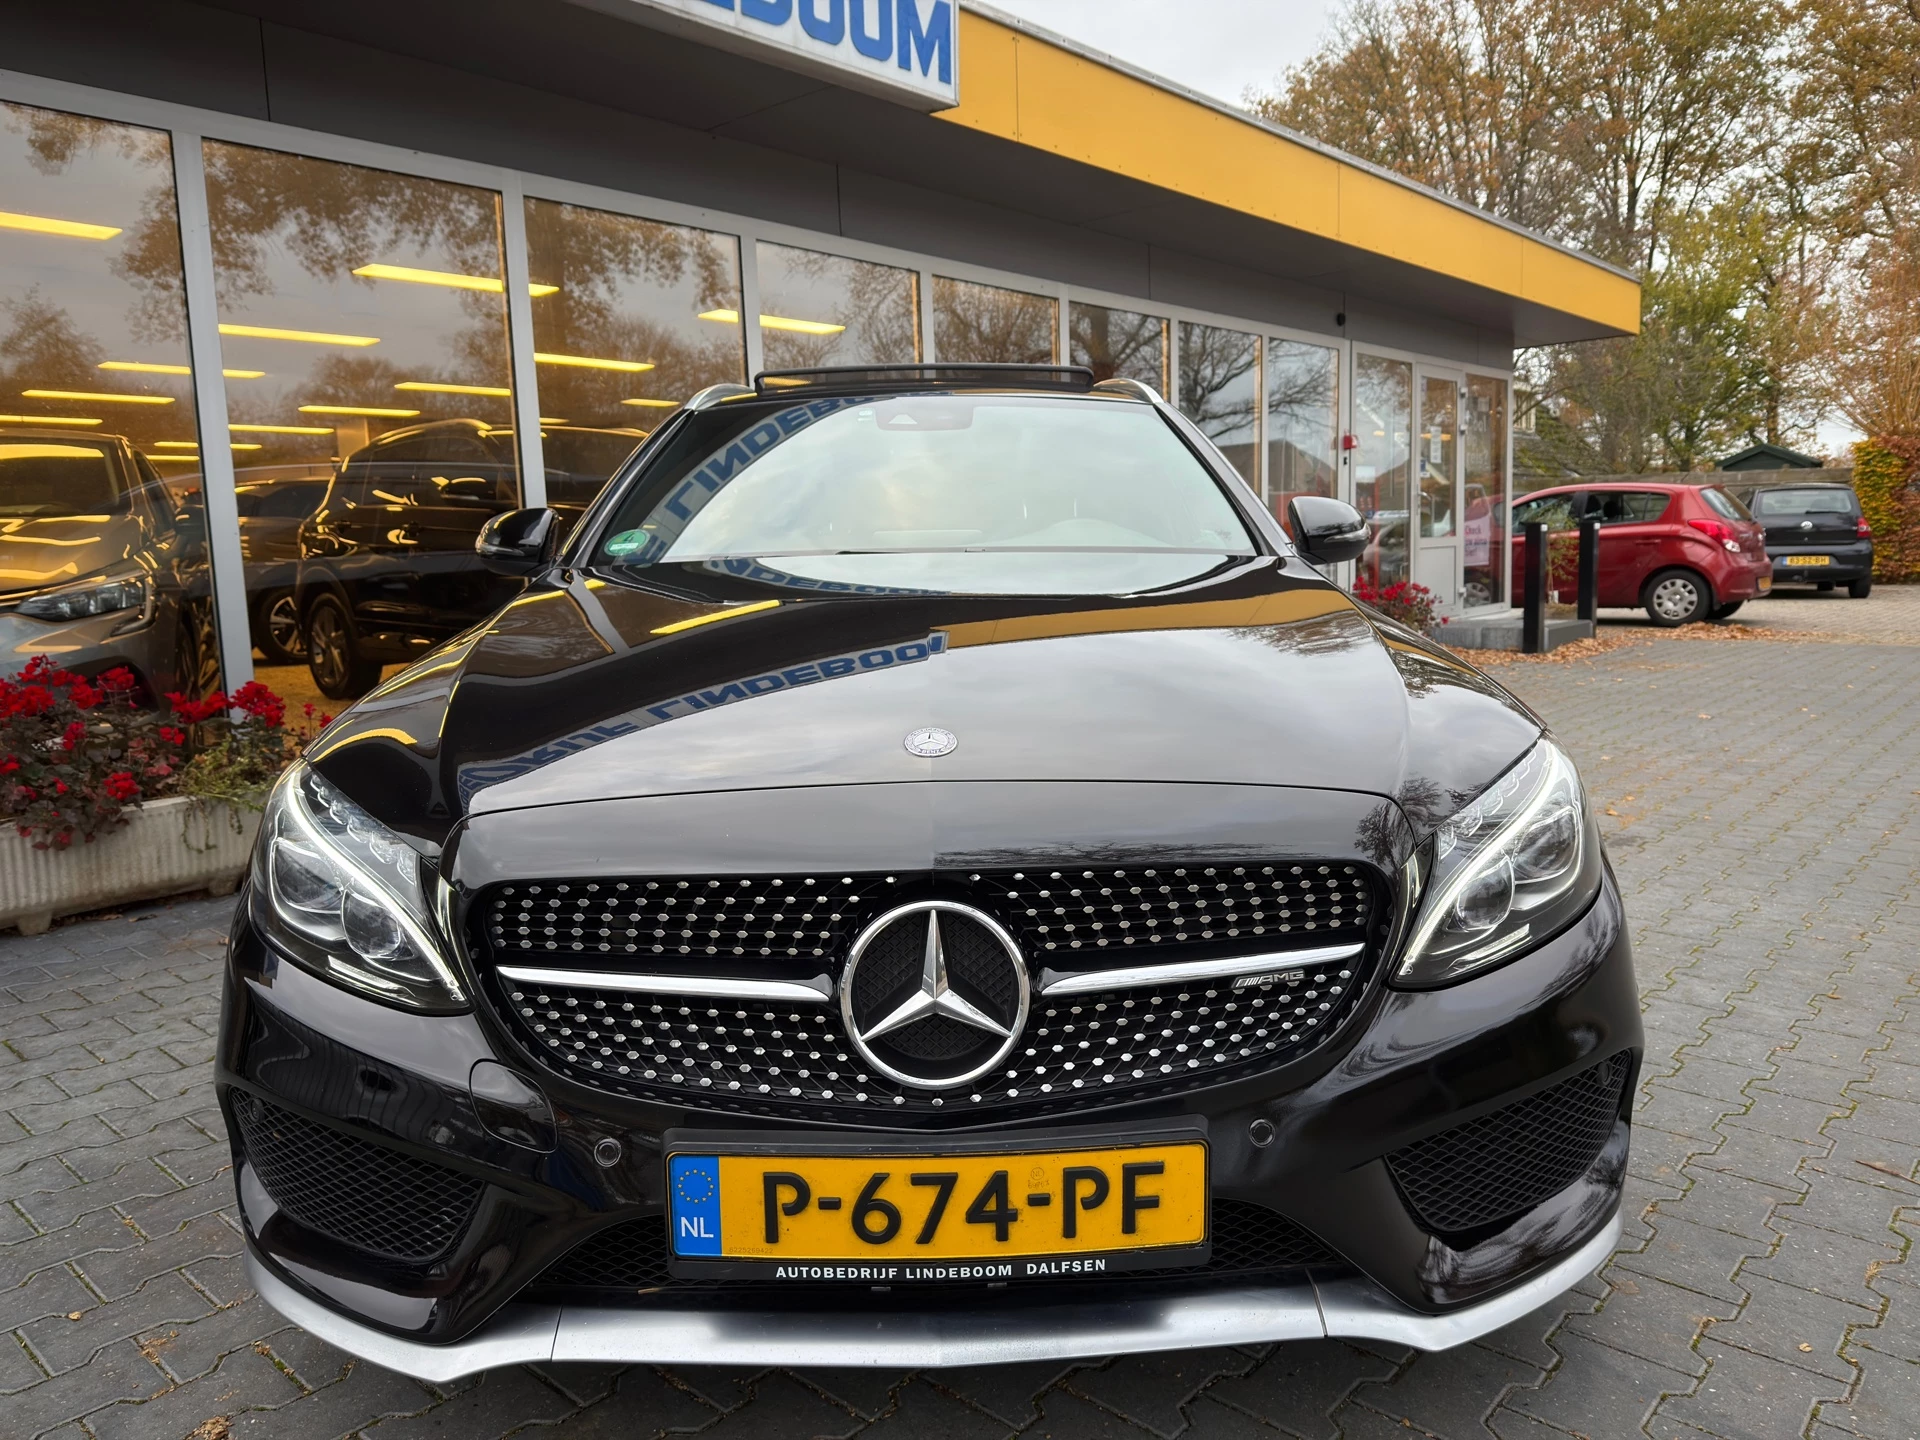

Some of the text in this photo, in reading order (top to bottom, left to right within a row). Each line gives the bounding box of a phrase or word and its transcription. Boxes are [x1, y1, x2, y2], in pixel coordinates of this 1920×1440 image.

[762, 1161, 1165, 1245] P-674-PF
[680, 1216, 714, 1239] NL
[775, 1259, 1107, 1279] AUTOBEDRIJF LINDEBOOM DALFSEN
